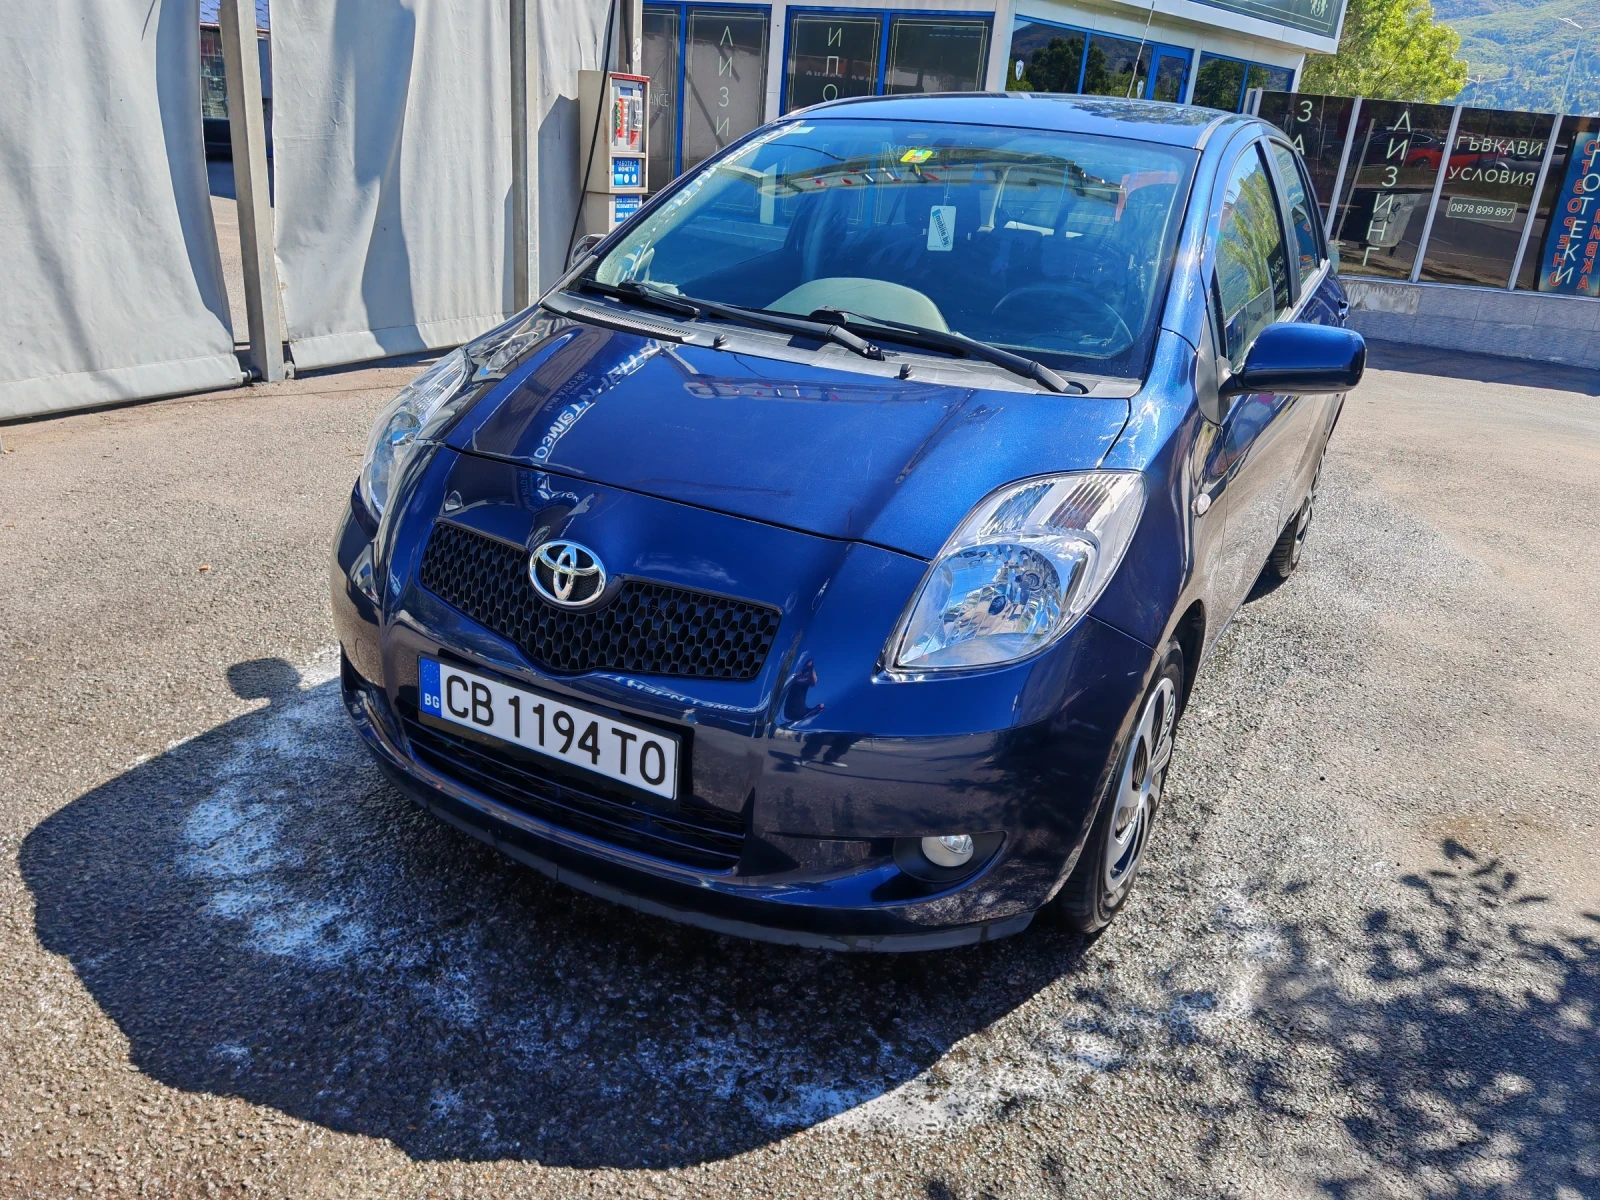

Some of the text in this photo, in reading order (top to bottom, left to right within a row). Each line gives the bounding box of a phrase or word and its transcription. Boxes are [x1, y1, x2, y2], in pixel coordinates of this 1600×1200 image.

[715, 25, 734, 153] ЛИЗИ
[1455, 136, 1544, 156] ГЪВКАВИ
[1448, 165, 1536, 186] УСЛОВИЯ
[1362, 111, 1411, 267] ЛИЗИНГ
[1450, 203, 1514, 217] 0878 899 897
[424, 692, 440, 709] BG
[446, 674, 494, 727] CB
[508, 695, 601, 765] 1194
[611, 727, 666, 786] TO
